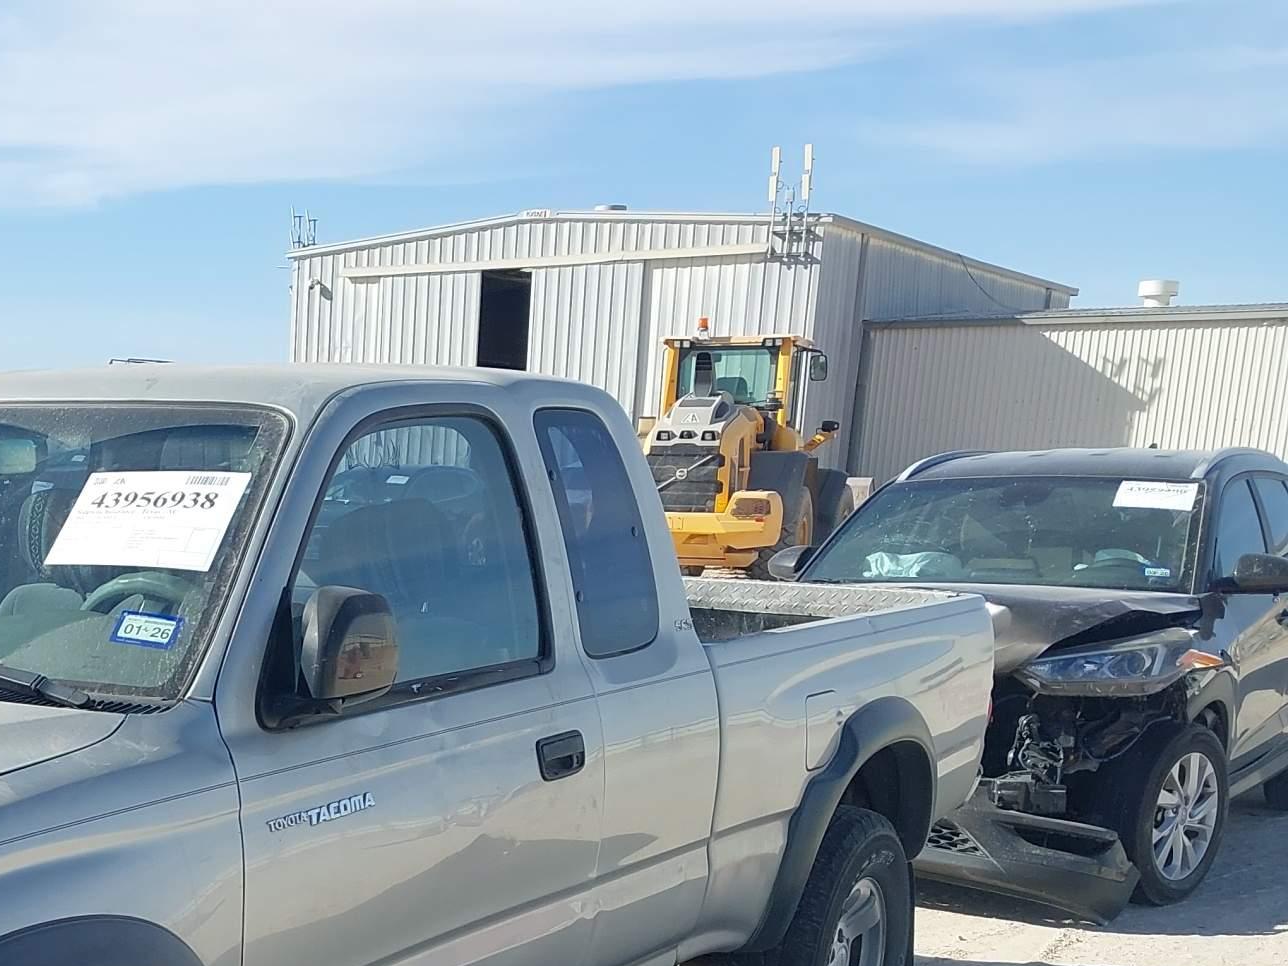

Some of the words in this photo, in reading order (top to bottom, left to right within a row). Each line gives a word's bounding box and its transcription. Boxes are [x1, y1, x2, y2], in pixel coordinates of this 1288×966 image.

[90, 490, 219, 510] 43956938
[266, 810, 309, 832] TOYOTA
[306, 792, 375, 826] TACOMA
